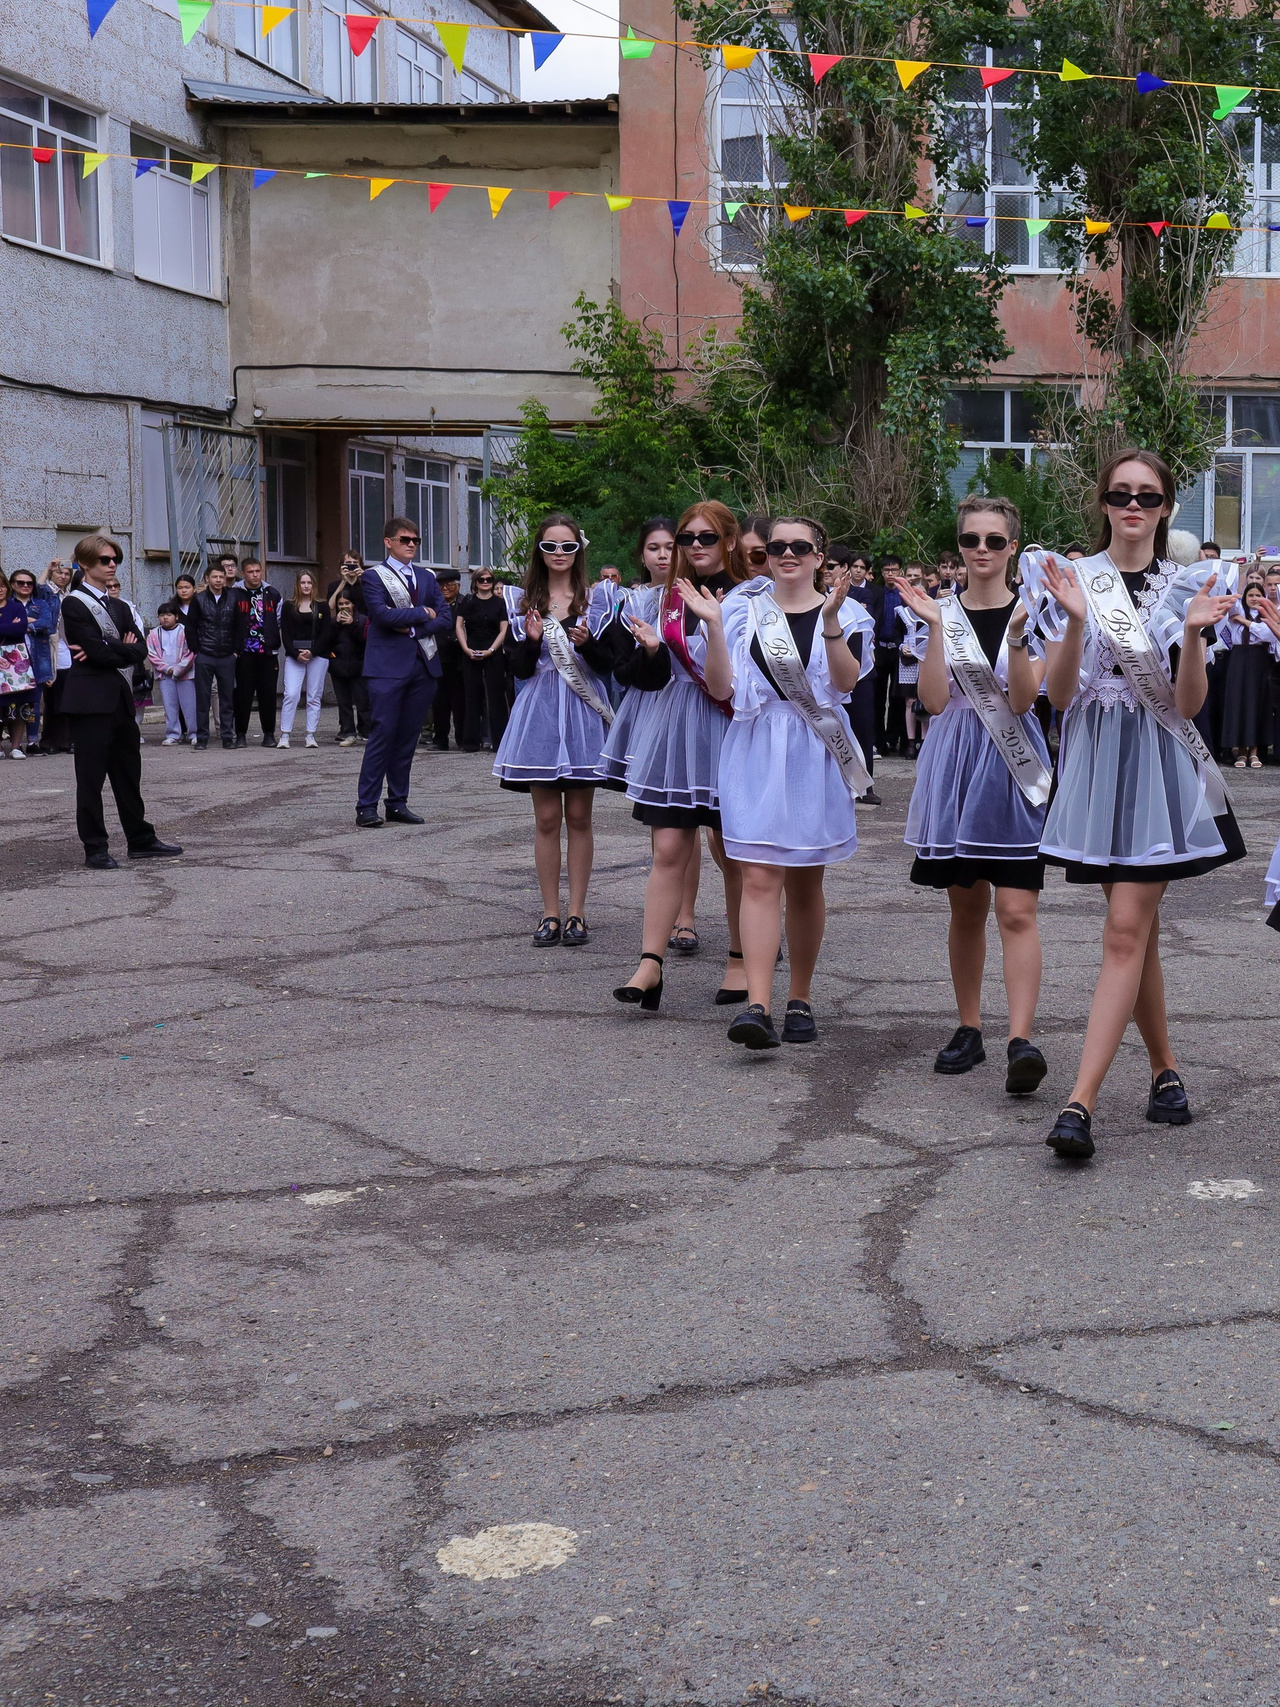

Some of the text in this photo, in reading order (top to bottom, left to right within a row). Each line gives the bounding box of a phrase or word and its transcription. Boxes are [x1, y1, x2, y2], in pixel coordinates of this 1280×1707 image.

[764, 637, 853, 766] Выпускница 2024
[942, 620, 997, 715] Выпускница
[999, 726, 1032, 768] 2024
[1102, 608, 1210, 763] Выпускница 2024
